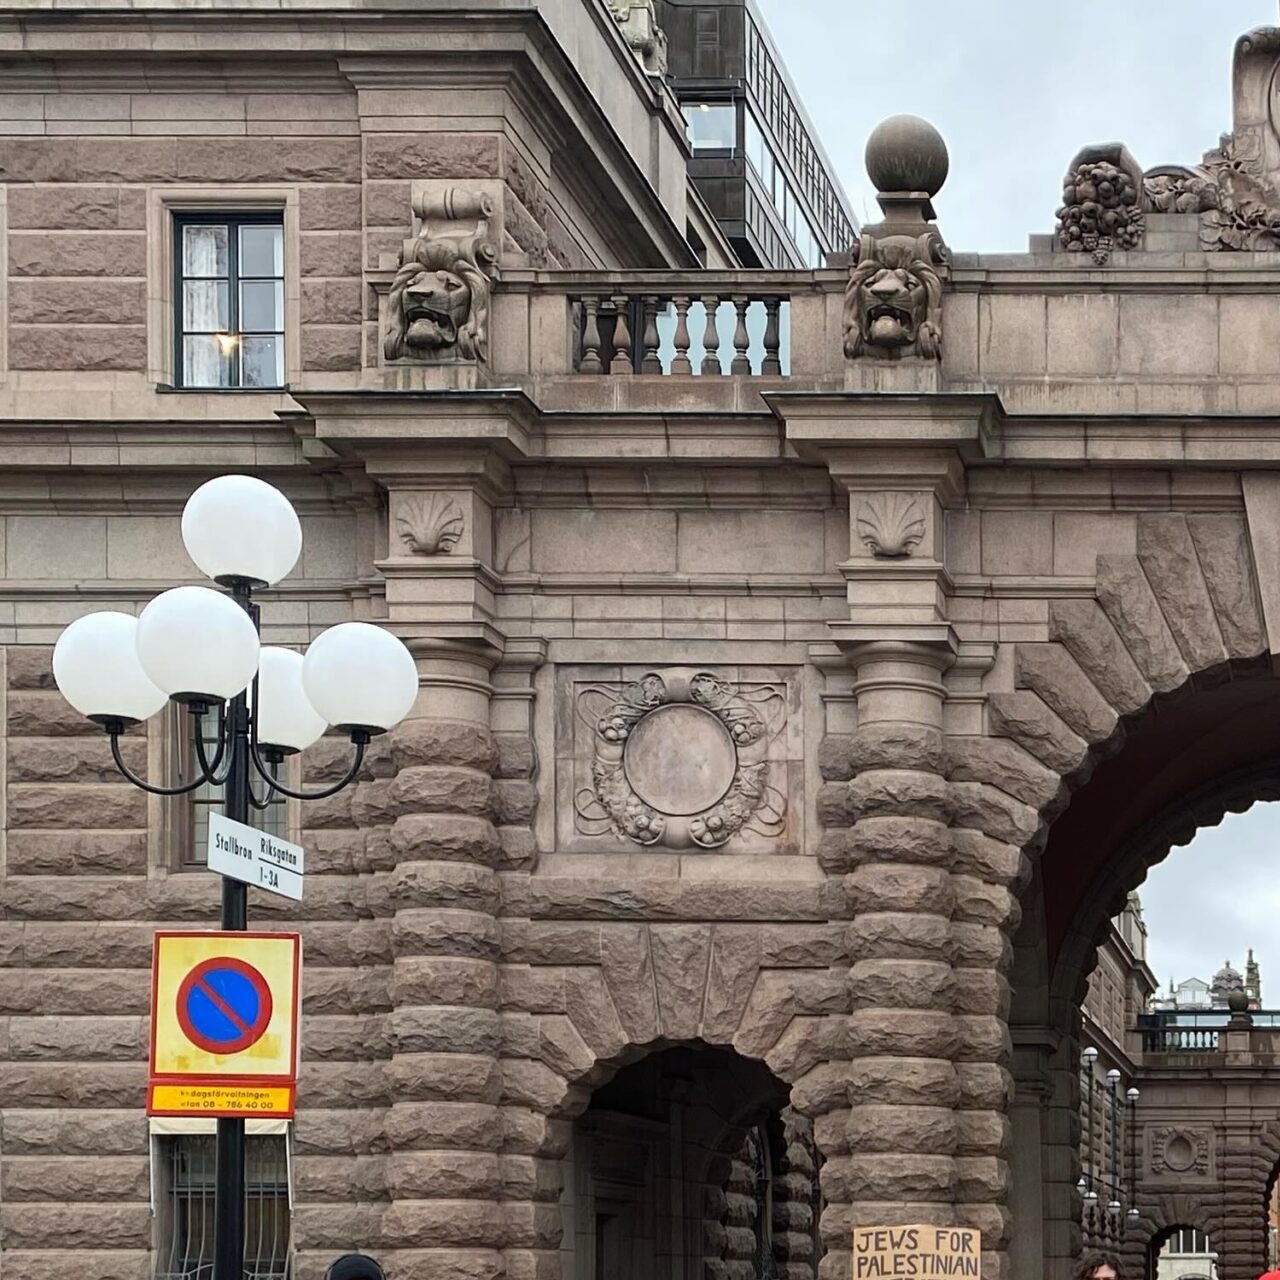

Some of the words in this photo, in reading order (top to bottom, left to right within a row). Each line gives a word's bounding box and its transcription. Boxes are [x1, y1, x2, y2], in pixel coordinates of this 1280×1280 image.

[215, 832, 252, 860] Stallbron
[260, 838, 297, 866] Riksgatan
[856, 1229, 919, 1253] JEWS
[936, 1230, 974, 1253] FOR
[857, 1253, 978, 1278] PALESTINIAN
